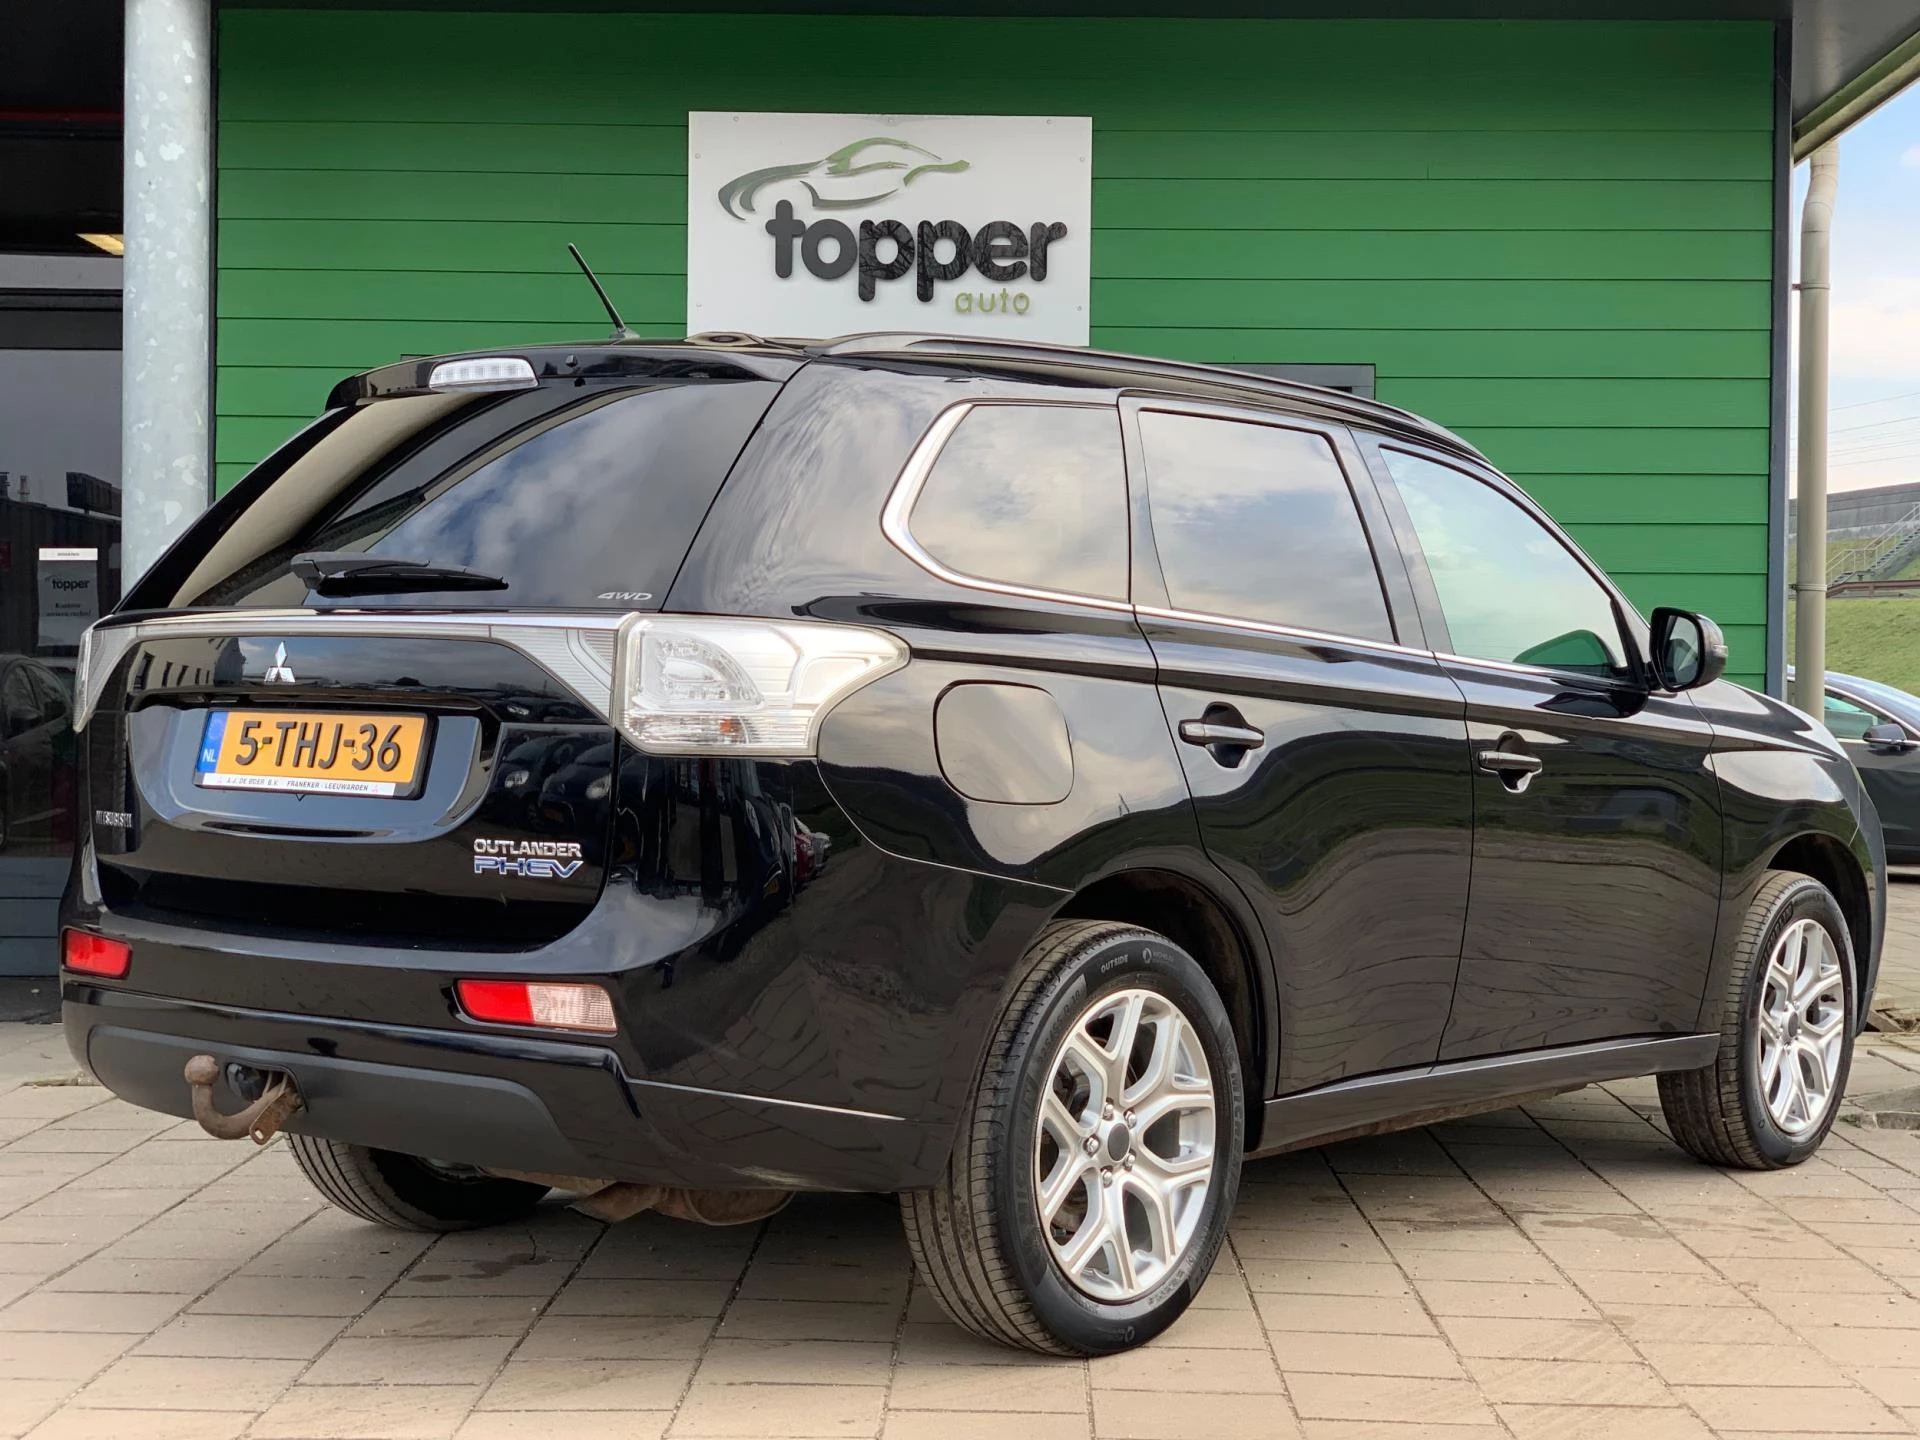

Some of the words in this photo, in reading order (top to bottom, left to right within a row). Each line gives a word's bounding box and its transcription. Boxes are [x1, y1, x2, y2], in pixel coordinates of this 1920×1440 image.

[765, 199, 1068, 302] topper
[955, 288, 1030, 315] auto
[52, 578, 90, 591] topper
[598, 592, 652, 601] 4WD
[202, 749, 217, 762] NL
[235, 720, 402, 772] 5-THJ-36
[287, 780, 320, 789] FRANEKER
[324, 782, 369, 792] LEEUWARDEN
[473, 838, 583, 857] OUTLANDER
[474, 855, 584, 878] PHEV
[1100, 953, 1129, 974] OUTSIDE
